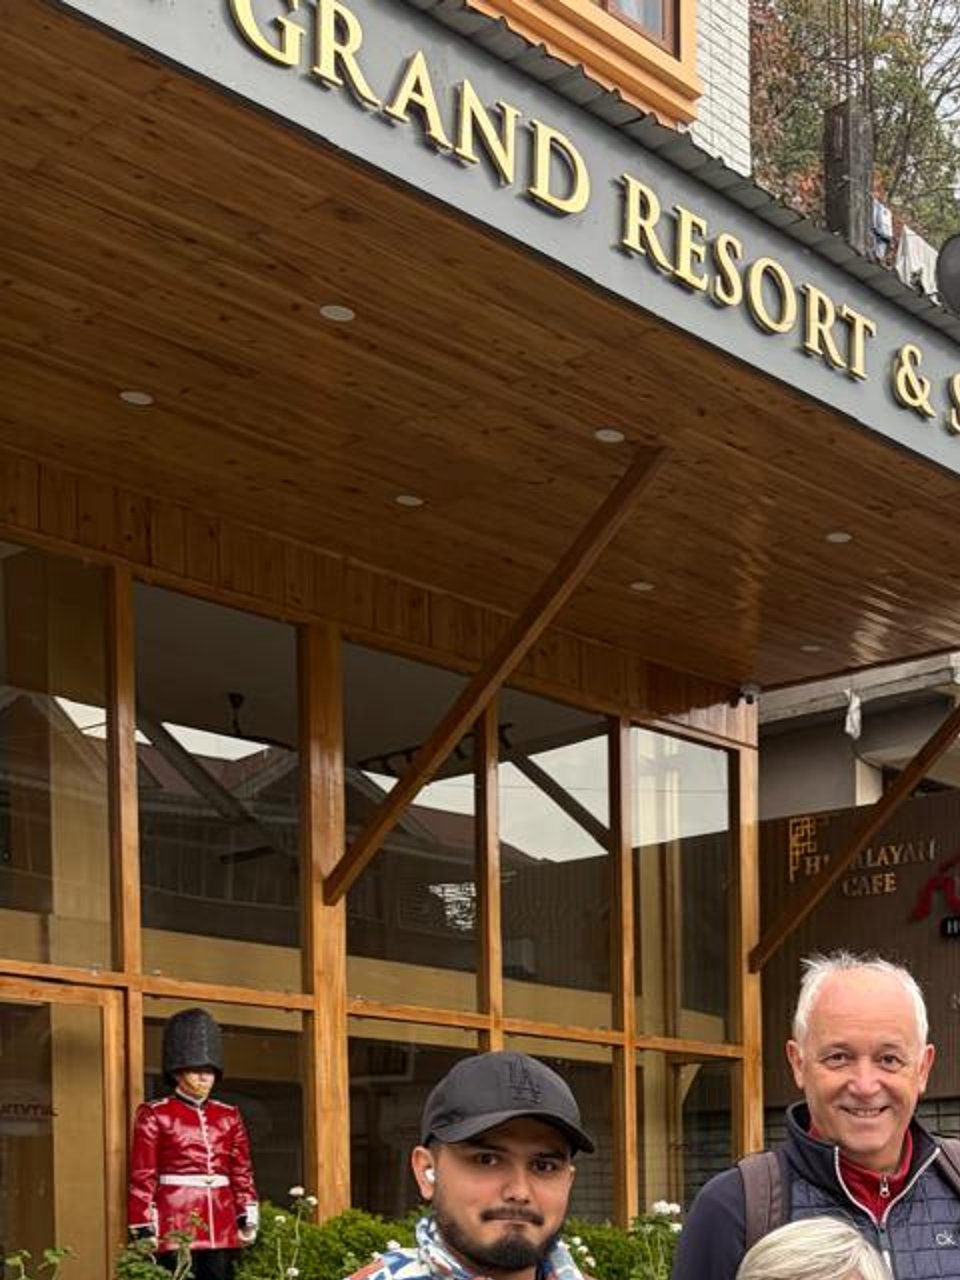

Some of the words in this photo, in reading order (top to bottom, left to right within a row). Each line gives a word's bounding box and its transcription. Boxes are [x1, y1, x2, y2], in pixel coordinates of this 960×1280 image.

[229, 0, 592, 215] GRAND
[617, 173, 877, 381] RESORT
[893, 343, 936, 420] &
